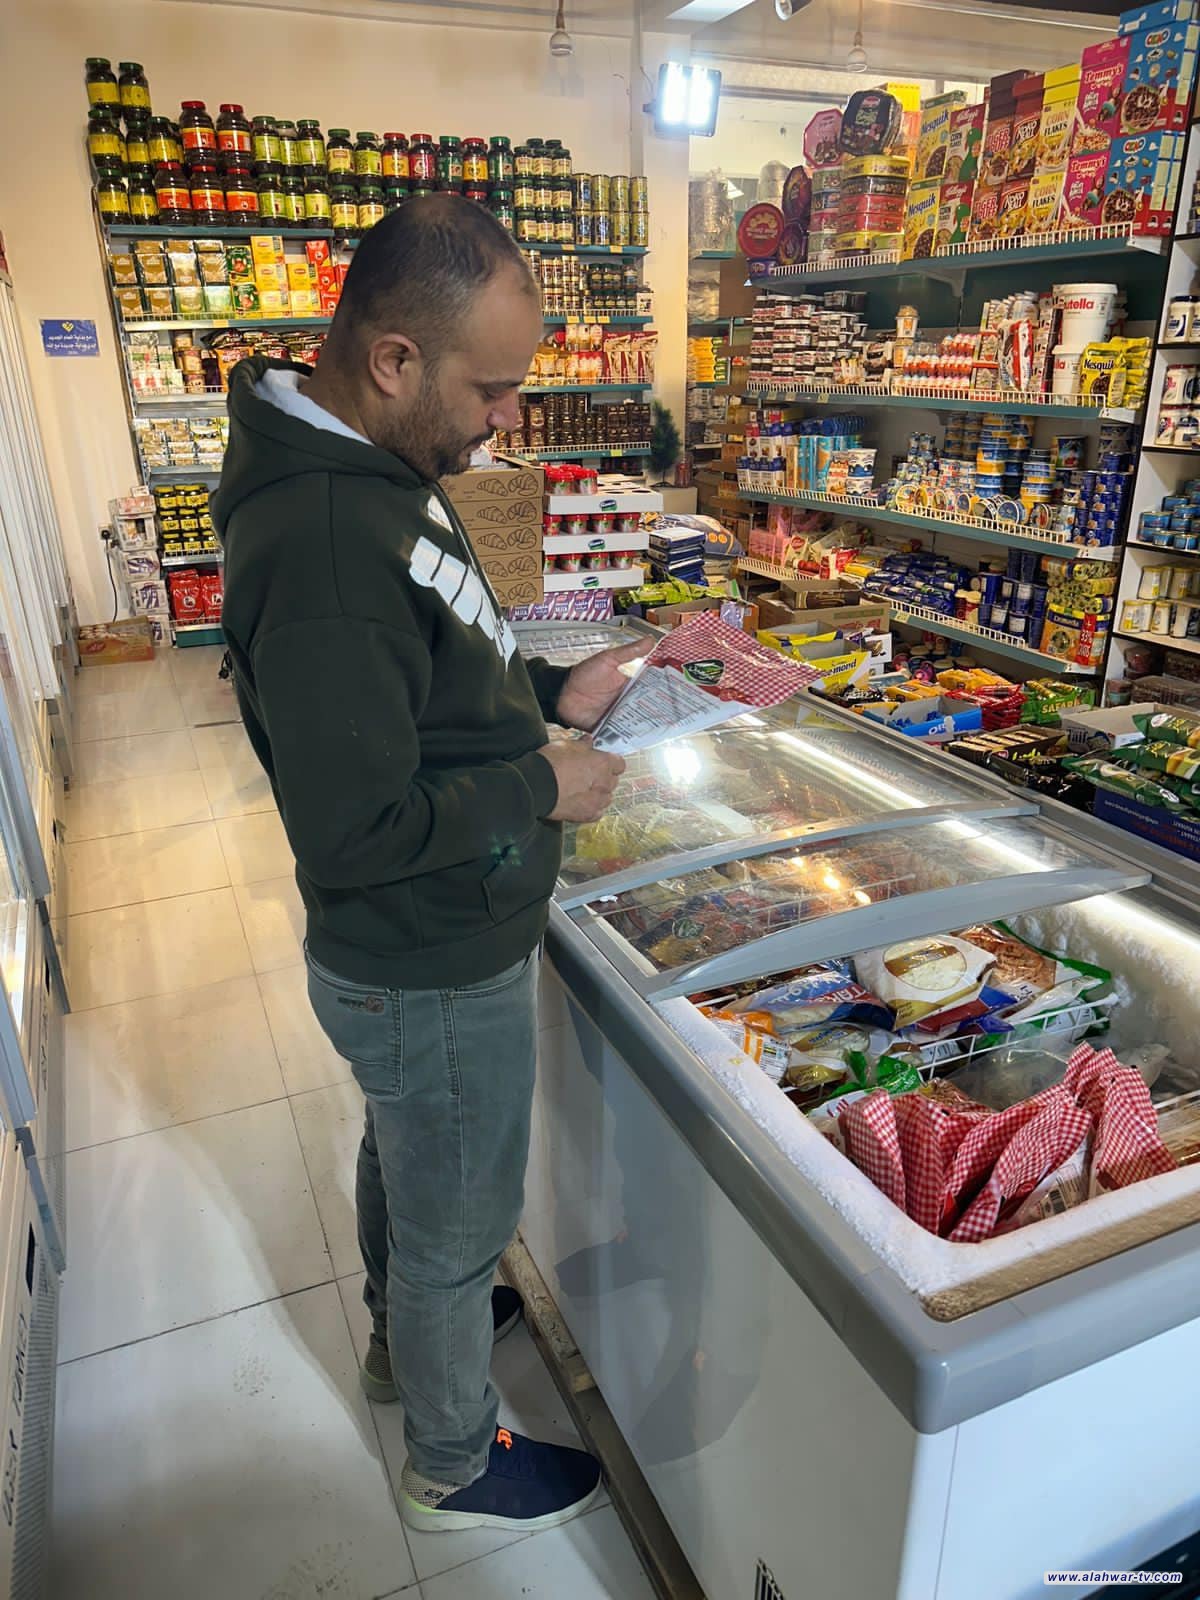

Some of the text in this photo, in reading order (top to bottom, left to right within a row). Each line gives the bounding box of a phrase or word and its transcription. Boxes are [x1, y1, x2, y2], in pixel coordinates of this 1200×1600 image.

[1044, 121, 1068, 136] FLAKES
[908, 193, 936, 216] Nesquik
[1032, 194, 1056, 209] FLAKES
